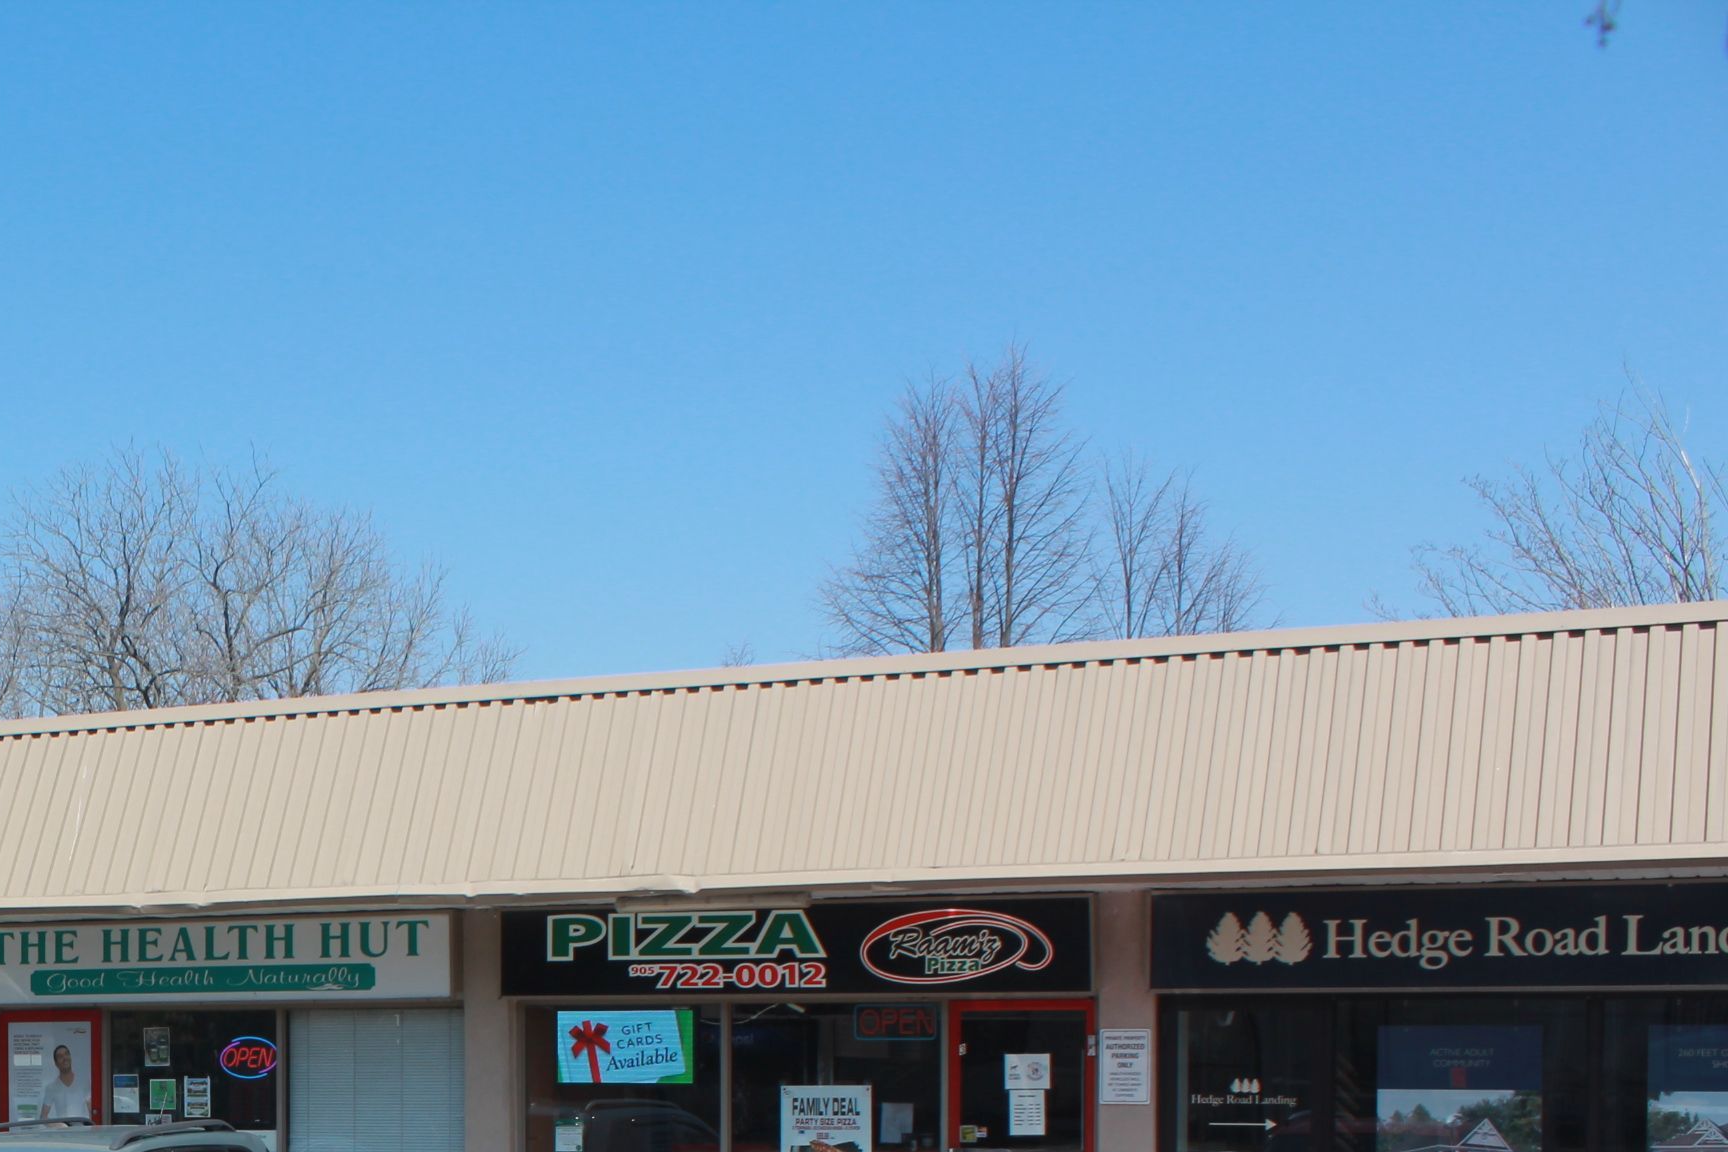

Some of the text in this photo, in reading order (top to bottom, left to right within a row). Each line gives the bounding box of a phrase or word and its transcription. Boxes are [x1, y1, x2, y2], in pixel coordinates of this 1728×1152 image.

[101, 923, 295, 963] HEALTH
[320, 920, 429, 958] HUT
[547, 910, 827, 961] PIZZA
[889, 926, 1001, 964] Raam'z
[1322, 918, 1472, 969] Hedge
[1484, 915, 1609, 957] Road
[629, 962, 826, 989] 905 722-0012
[925, 957, 981, 974] Pizza
[47, 967, 360, 993] Good Health Naturally
[621, 1022, 652, 1035] GIFT
[859, 1008, 935, 1036] OPEN
[617, 1034, 663, 1049] CARDS
[223, 1047, 273, 1068] OPEN
[607, 1047, 678, 1071] Available
[793, 1097, 860, 1116] FAMILY DEAL
[1192, 1094, 1297, 1107] Hedge Road Landing
